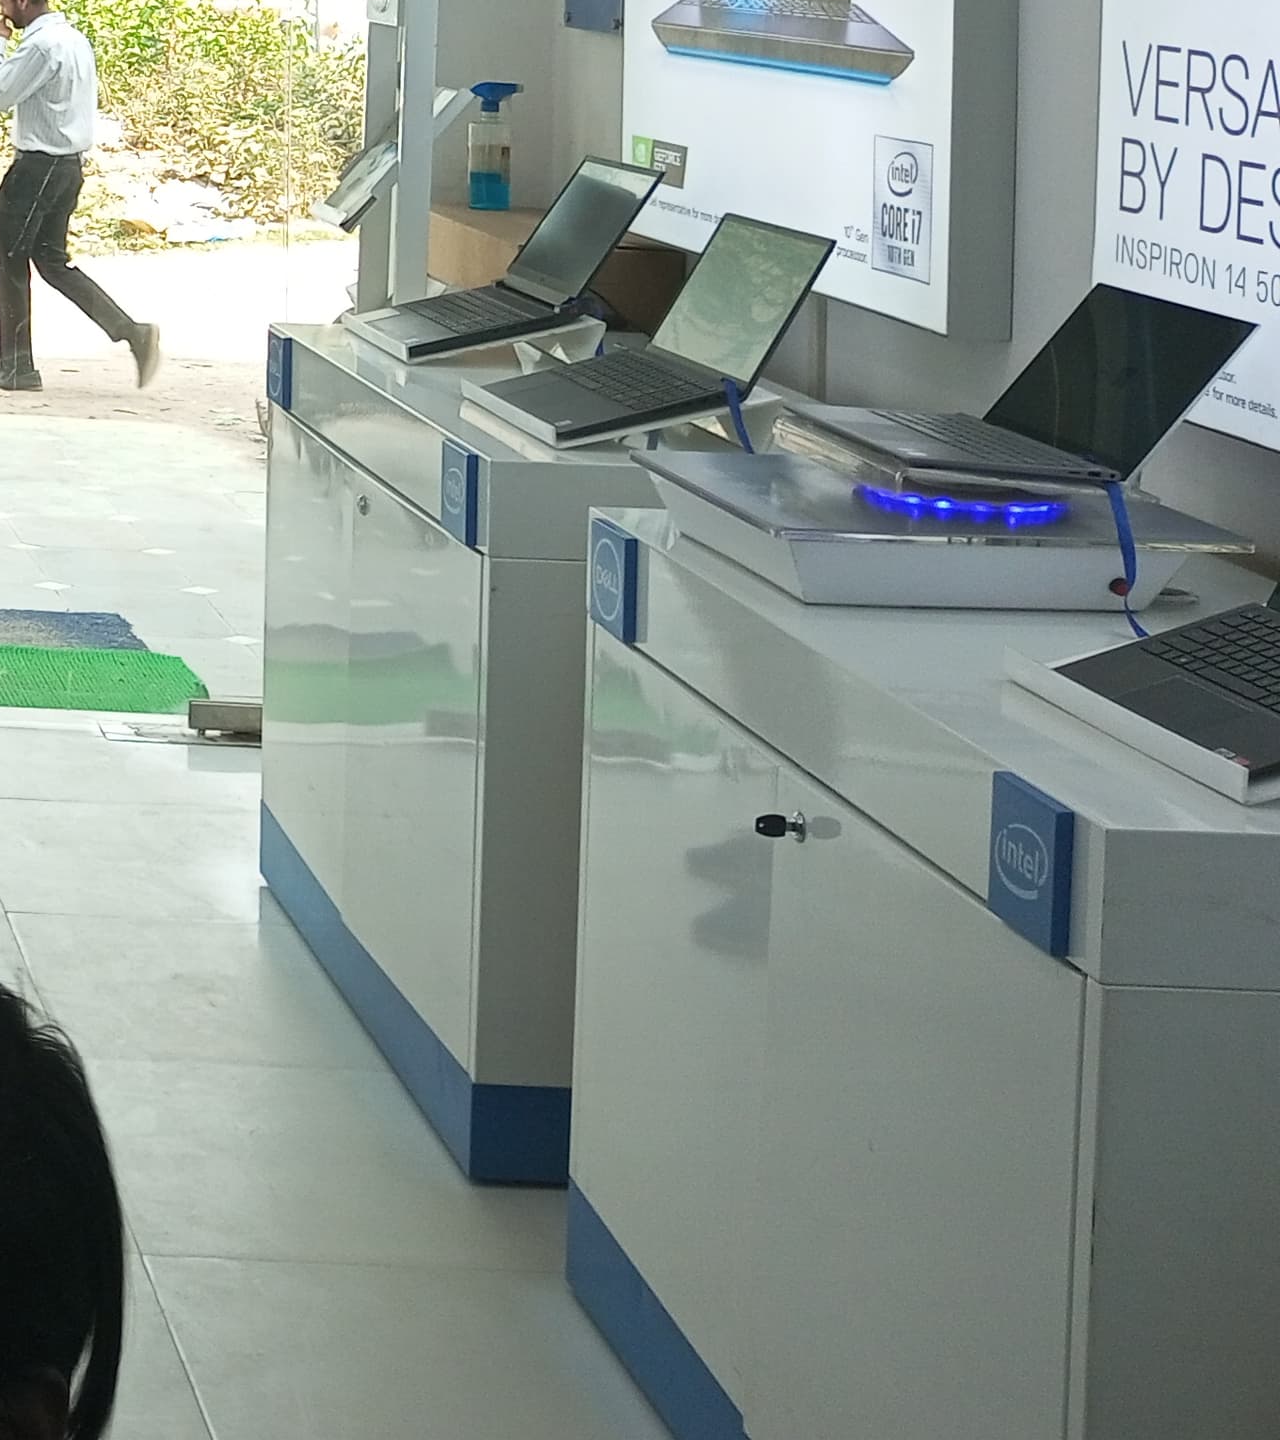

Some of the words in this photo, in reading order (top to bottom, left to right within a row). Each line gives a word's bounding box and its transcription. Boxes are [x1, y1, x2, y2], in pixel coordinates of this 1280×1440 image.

[891, 161, 914, 184] intel
[1119, 137, 1178, 222] BY
[881, 202, 909, 242] CORE
[912, 209, 922, 245] i7
[1115, 234, 1216, 290] INSPIRON
[1225, 263, 1246, 298] 14
[596, 563, 618, 595] DELL
[1002, 827, 1039, 884] intel
